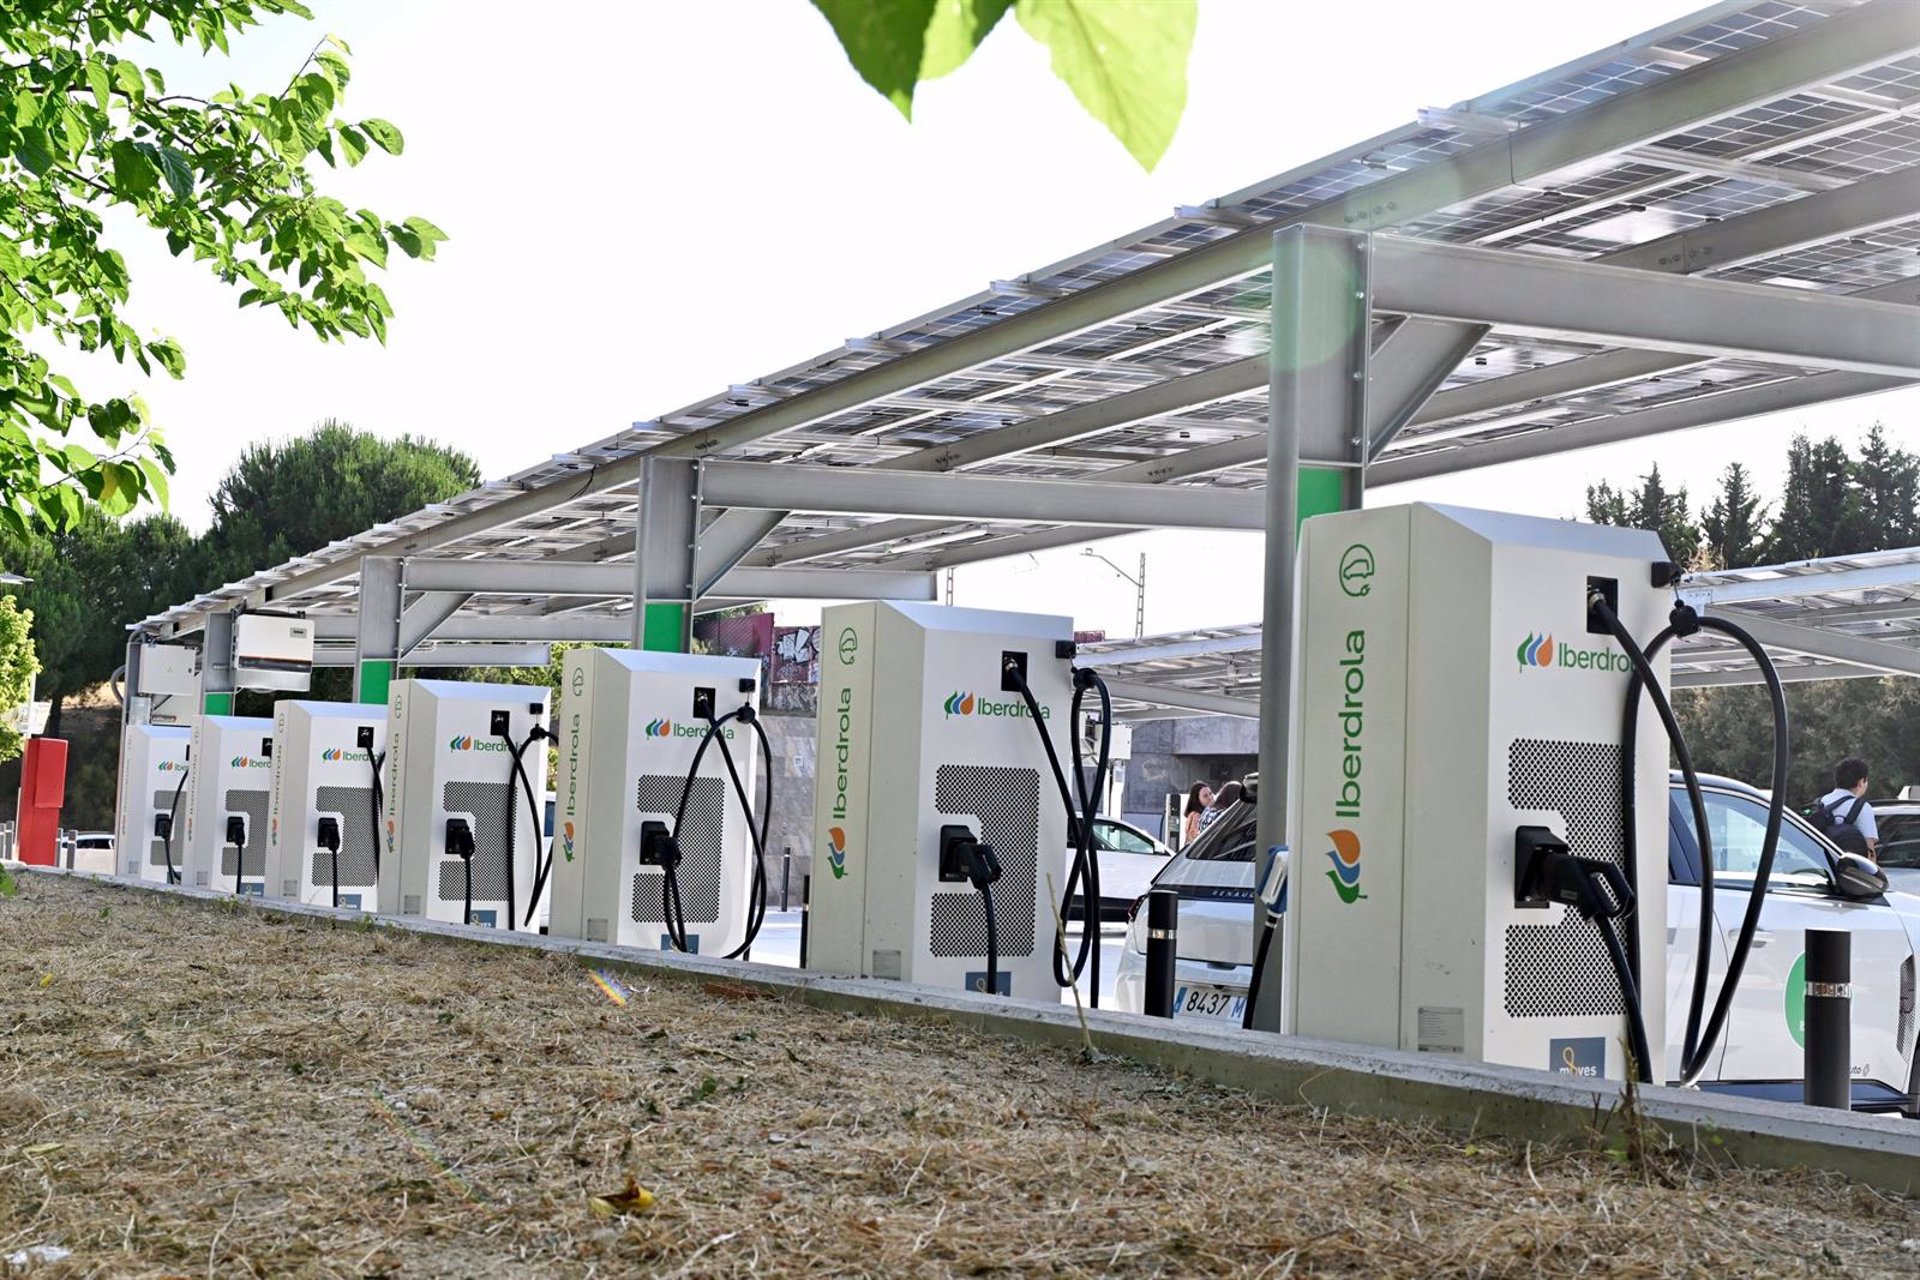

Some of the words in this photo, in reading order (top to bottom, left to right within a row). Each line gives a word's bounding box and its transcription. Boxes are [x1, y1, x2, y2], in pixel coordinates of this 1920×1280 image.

[566, 714, 581, 817] Iberdrola
[673, 723, 735, 739] Iberdla
[832, 687, 852, 820] Iberdrola
[1335, 629, 1366, 818] Iberdrola
[389, 733, 399, 816] Iberdrola
[1186, 991, 1231, 1016] 8437
